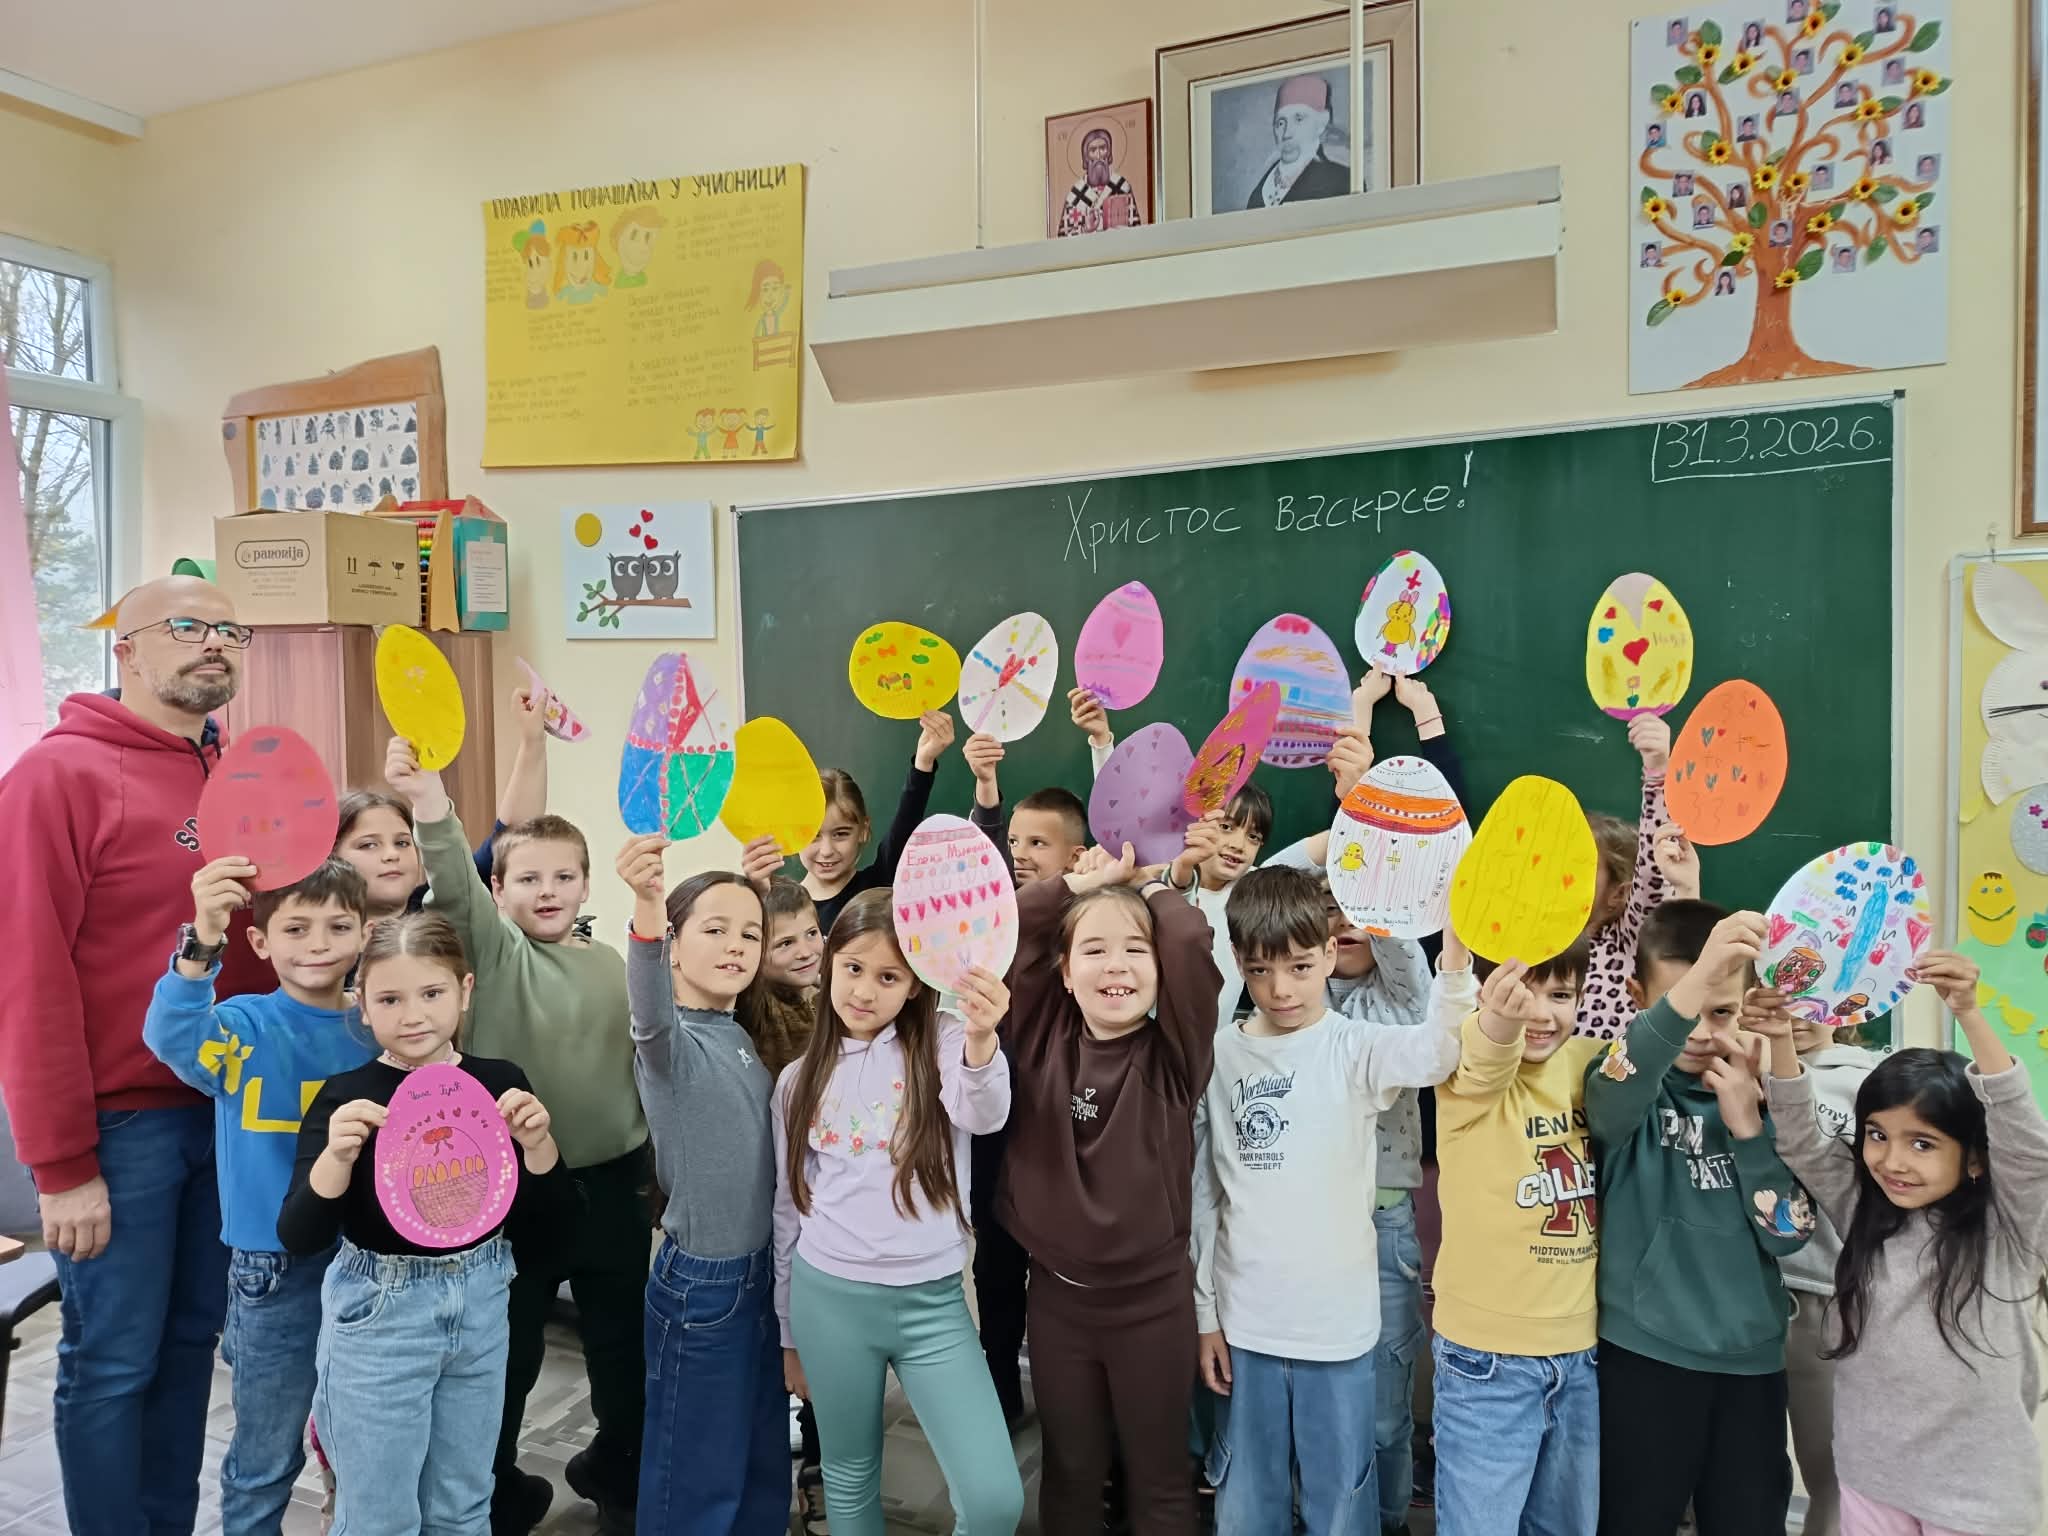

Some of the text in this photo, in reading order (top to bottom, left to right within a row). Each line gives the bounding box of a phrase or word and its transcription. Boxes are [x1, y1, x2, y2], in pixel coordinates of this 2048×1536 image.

[670, 176, 681, 199] У
[691, 166, 787, 198] УЧИОНИЦИ
[1665, 416, 1883, 468] 31.3.2026.
[1064, 488, 1242, 574] Христос
[1231, 1070, 1296, 1113] Northland
[1254, 1152, 1285, 1161] PATROLS
[1529, 1245, 1575, 1257] MIDTOWN
